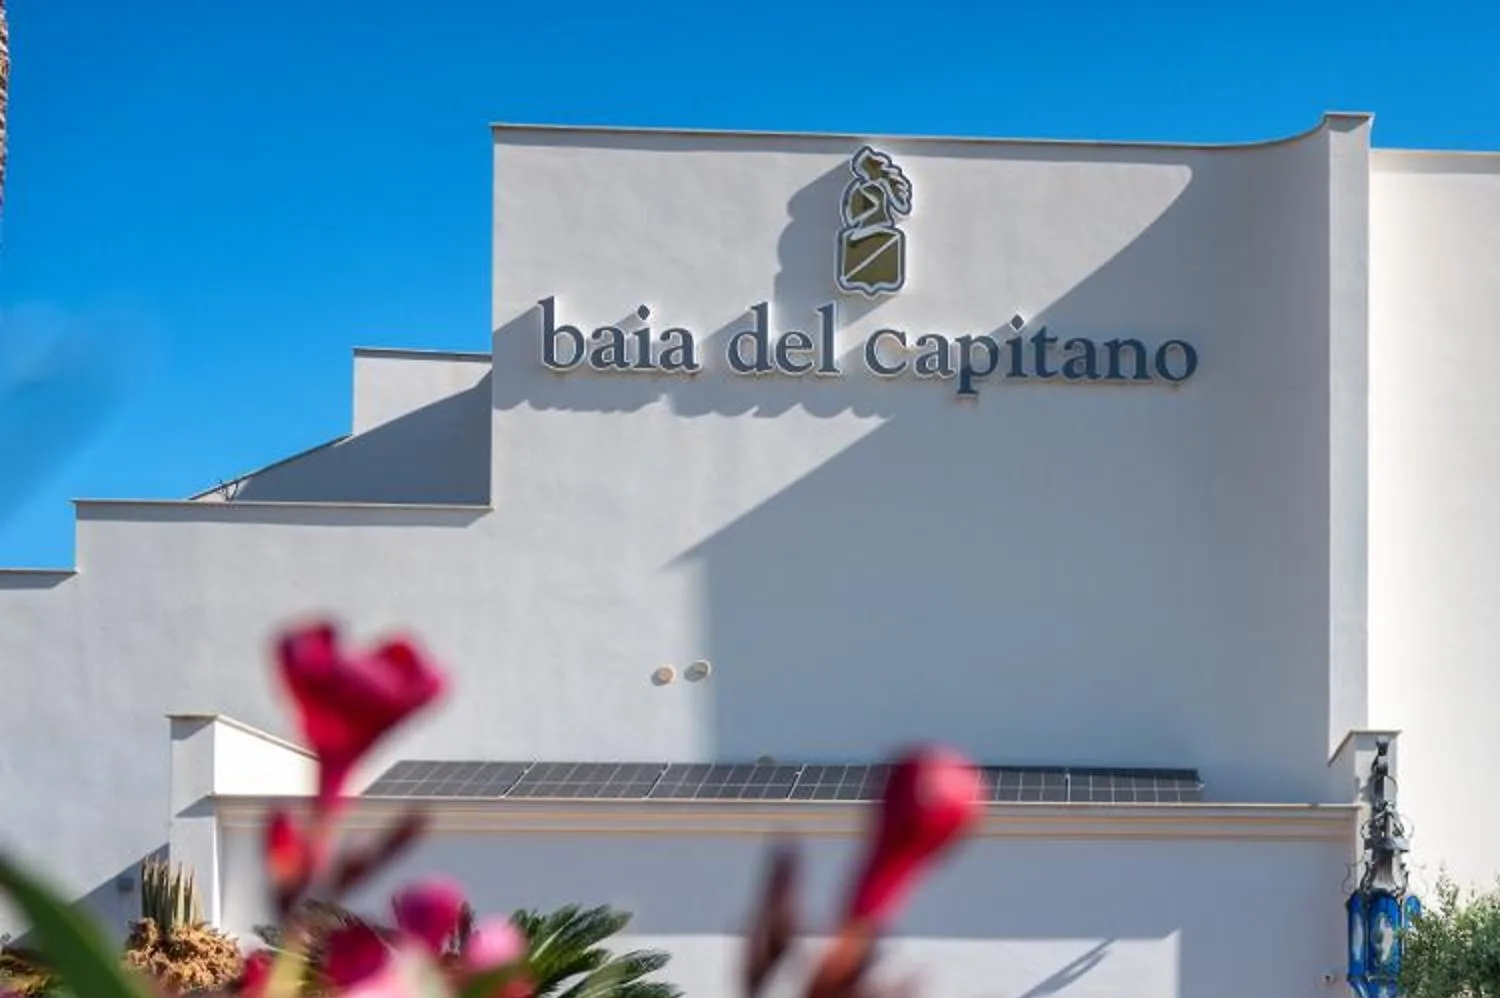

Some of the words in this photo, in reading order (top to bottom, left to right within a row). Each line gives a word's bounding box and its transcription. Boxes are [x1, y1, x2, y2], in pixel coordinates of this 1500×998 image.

[539, 296, 698, 370] baia
[728, 302, 838, 373] del
[865, 314, 1198, 394] capitano
